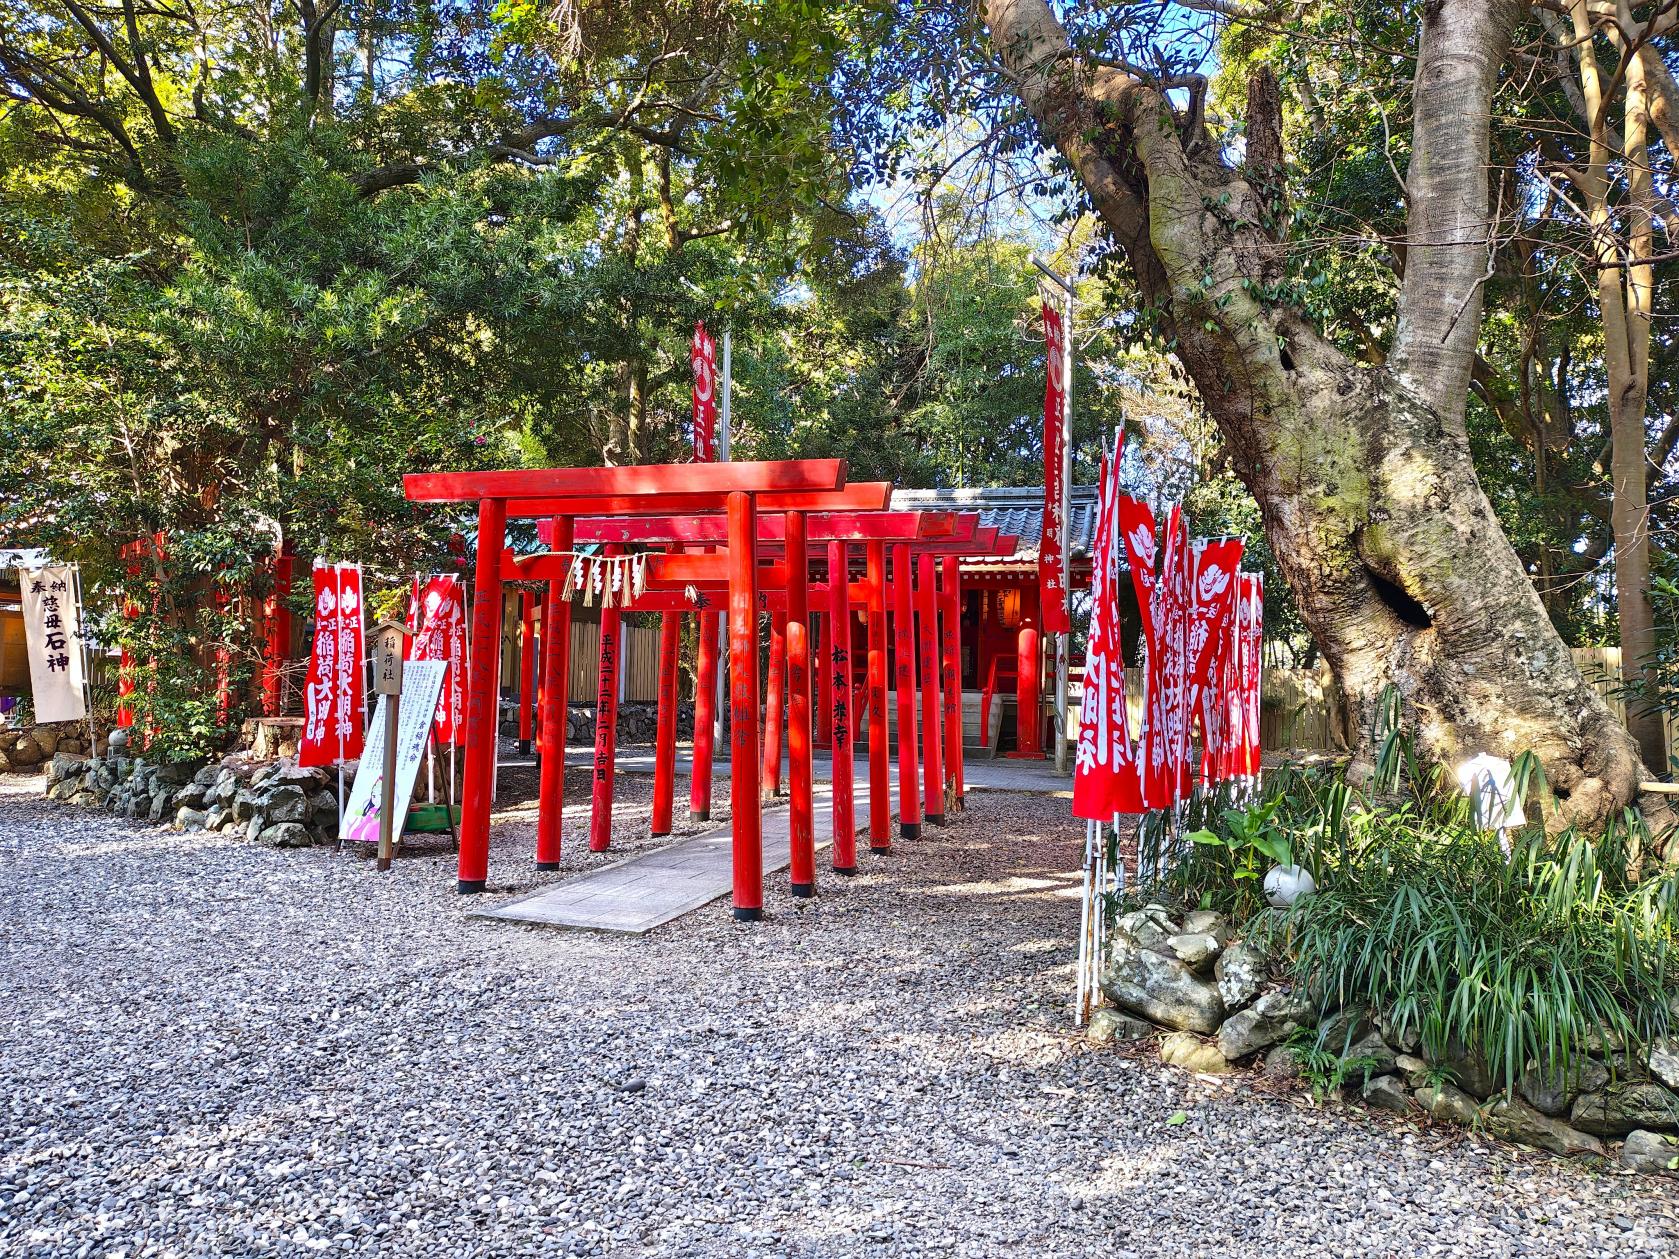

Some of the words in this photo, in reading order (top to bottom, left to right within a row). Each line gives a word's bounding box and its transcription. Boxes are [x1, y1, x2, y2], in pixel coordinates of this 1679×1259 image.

[30, 580, 67, 594] 奉納
[42, 596, 70, 673] 慈母石神
[383, 636, 396, 682] 稲荷社
[595, 634, 615, 782] 平成二十二年二月吉日
